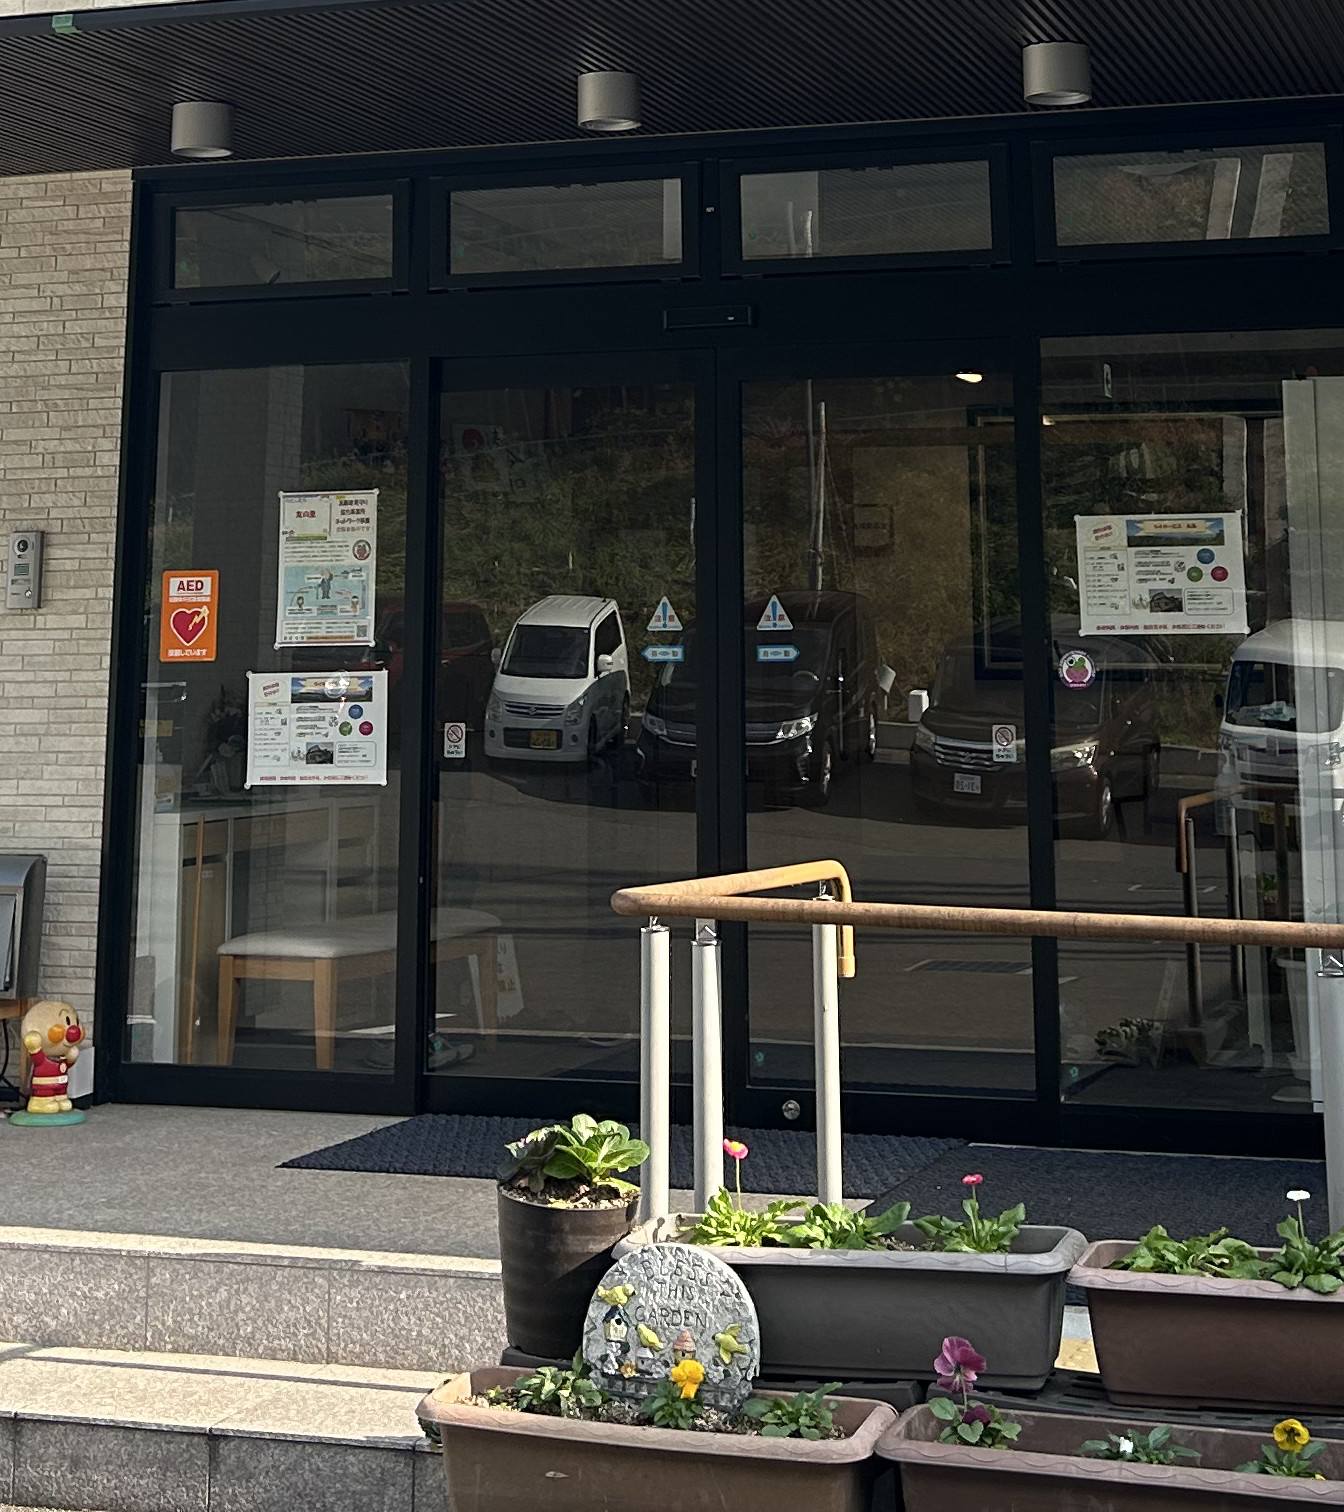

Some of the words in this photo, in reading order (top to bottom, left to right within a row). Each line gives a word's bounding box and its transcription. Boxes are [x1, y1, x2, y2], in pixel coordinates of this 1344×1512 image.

[177, 579, 205, 592] AED
[640, 1258, 713, 1287] BLESS
[655, 1280, 695, 1301] THIS
[634, 1304, 708, 1329] GARDEN
